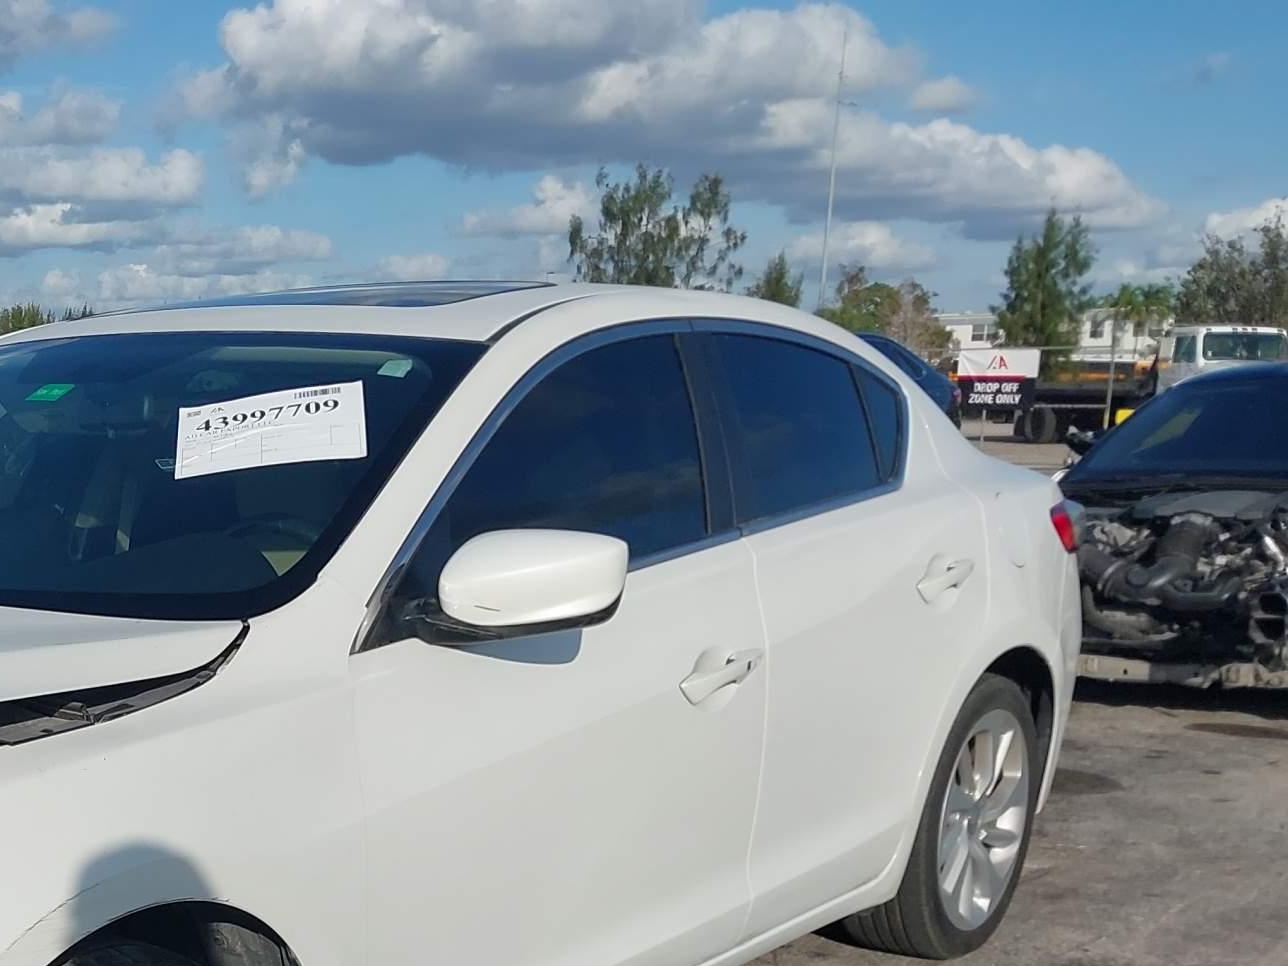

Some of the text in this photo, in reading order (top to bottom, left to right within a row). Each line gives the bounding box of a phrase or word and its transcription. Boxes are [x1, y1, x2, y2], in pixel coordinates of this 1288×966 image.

[973, 382, 1019, 393] DROP OFF
[968, 394, 1022, 404] ZONE ONLY
[196, 399, 339, 431] 43997709
